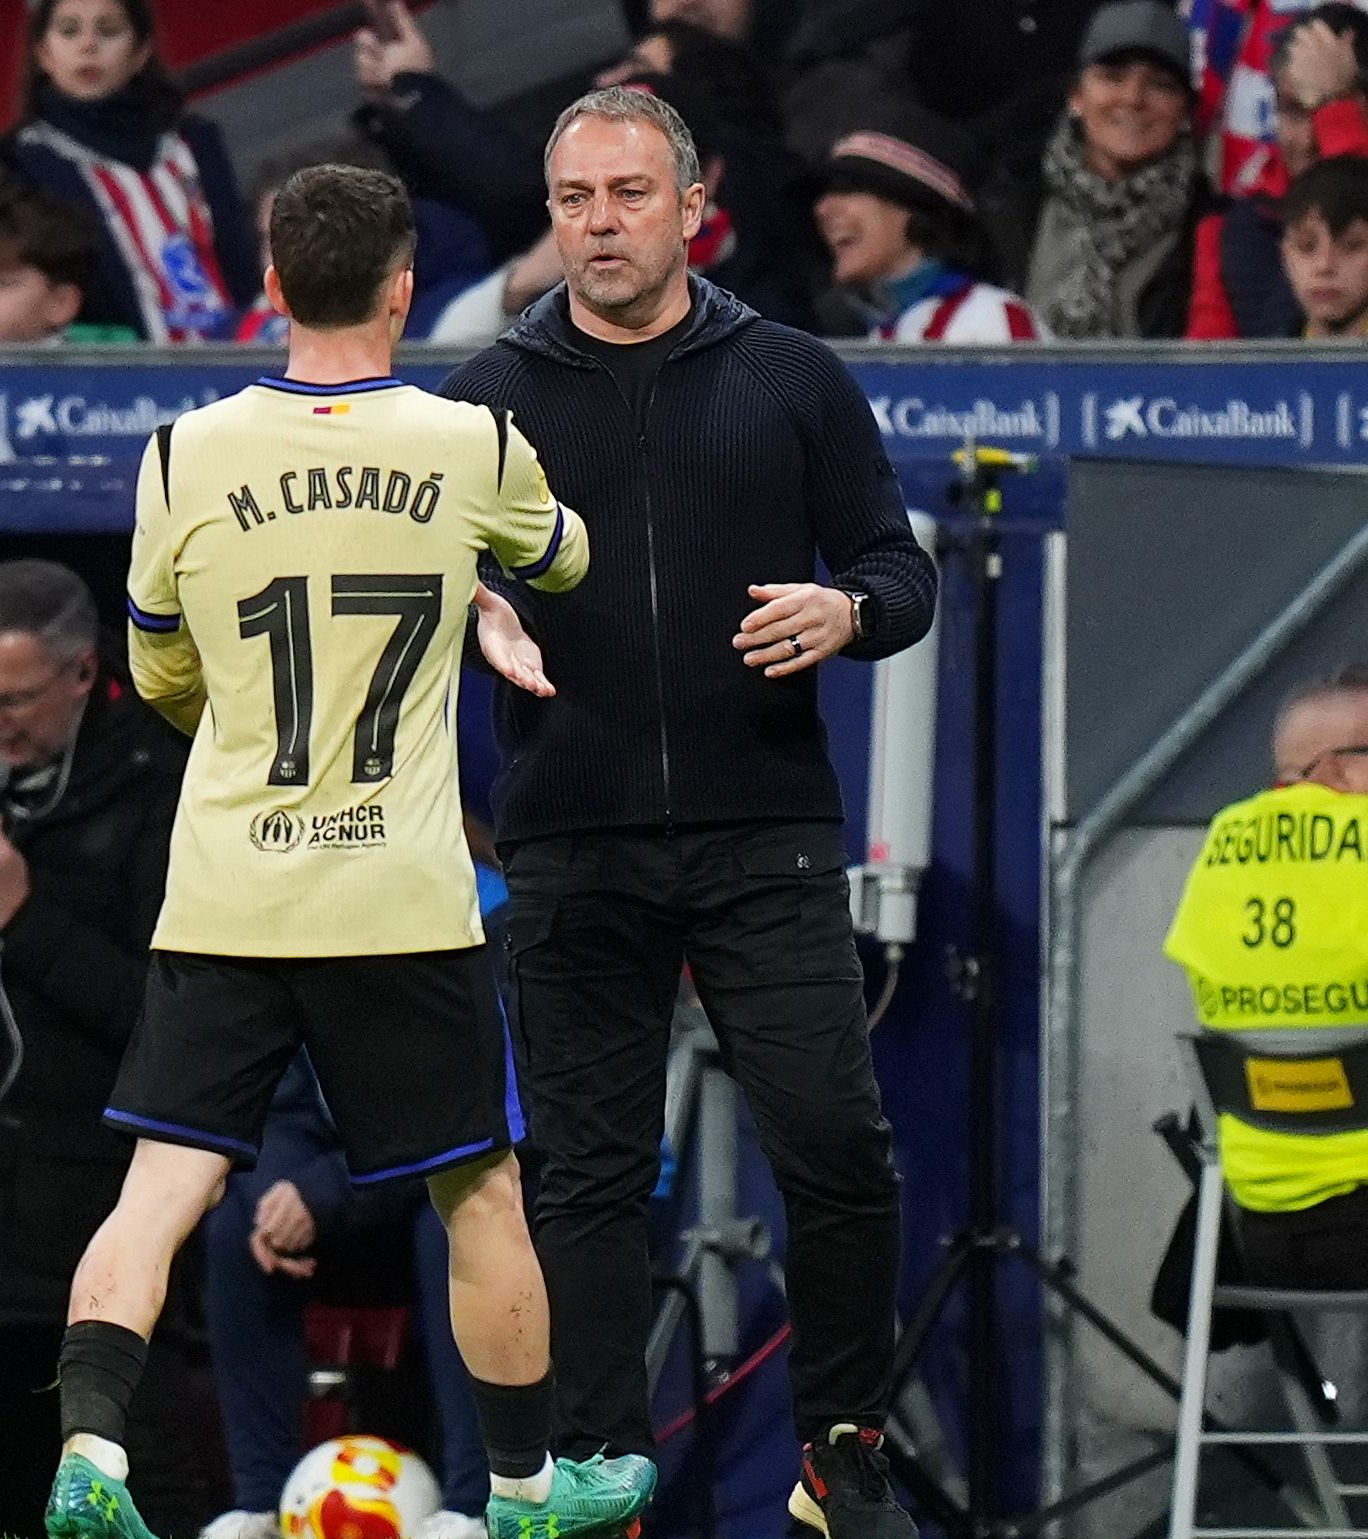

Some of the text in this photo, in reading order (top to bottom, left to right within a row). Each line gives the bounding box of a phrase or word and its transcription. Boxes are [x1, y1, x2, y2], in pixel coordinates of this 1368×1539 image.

[1147, 397, 1296, 437] CaixaBank
[227, 466, 444, 532] M. CASADÓ
[236, 573, 445, 785] 17
[307, 823, 385, 845] ACNUR
[312, 805, 384, 830] UNHCR
[1242, 897, 1295, 949] 38
[1221, 981, 1368, 1015] PROSEGU
